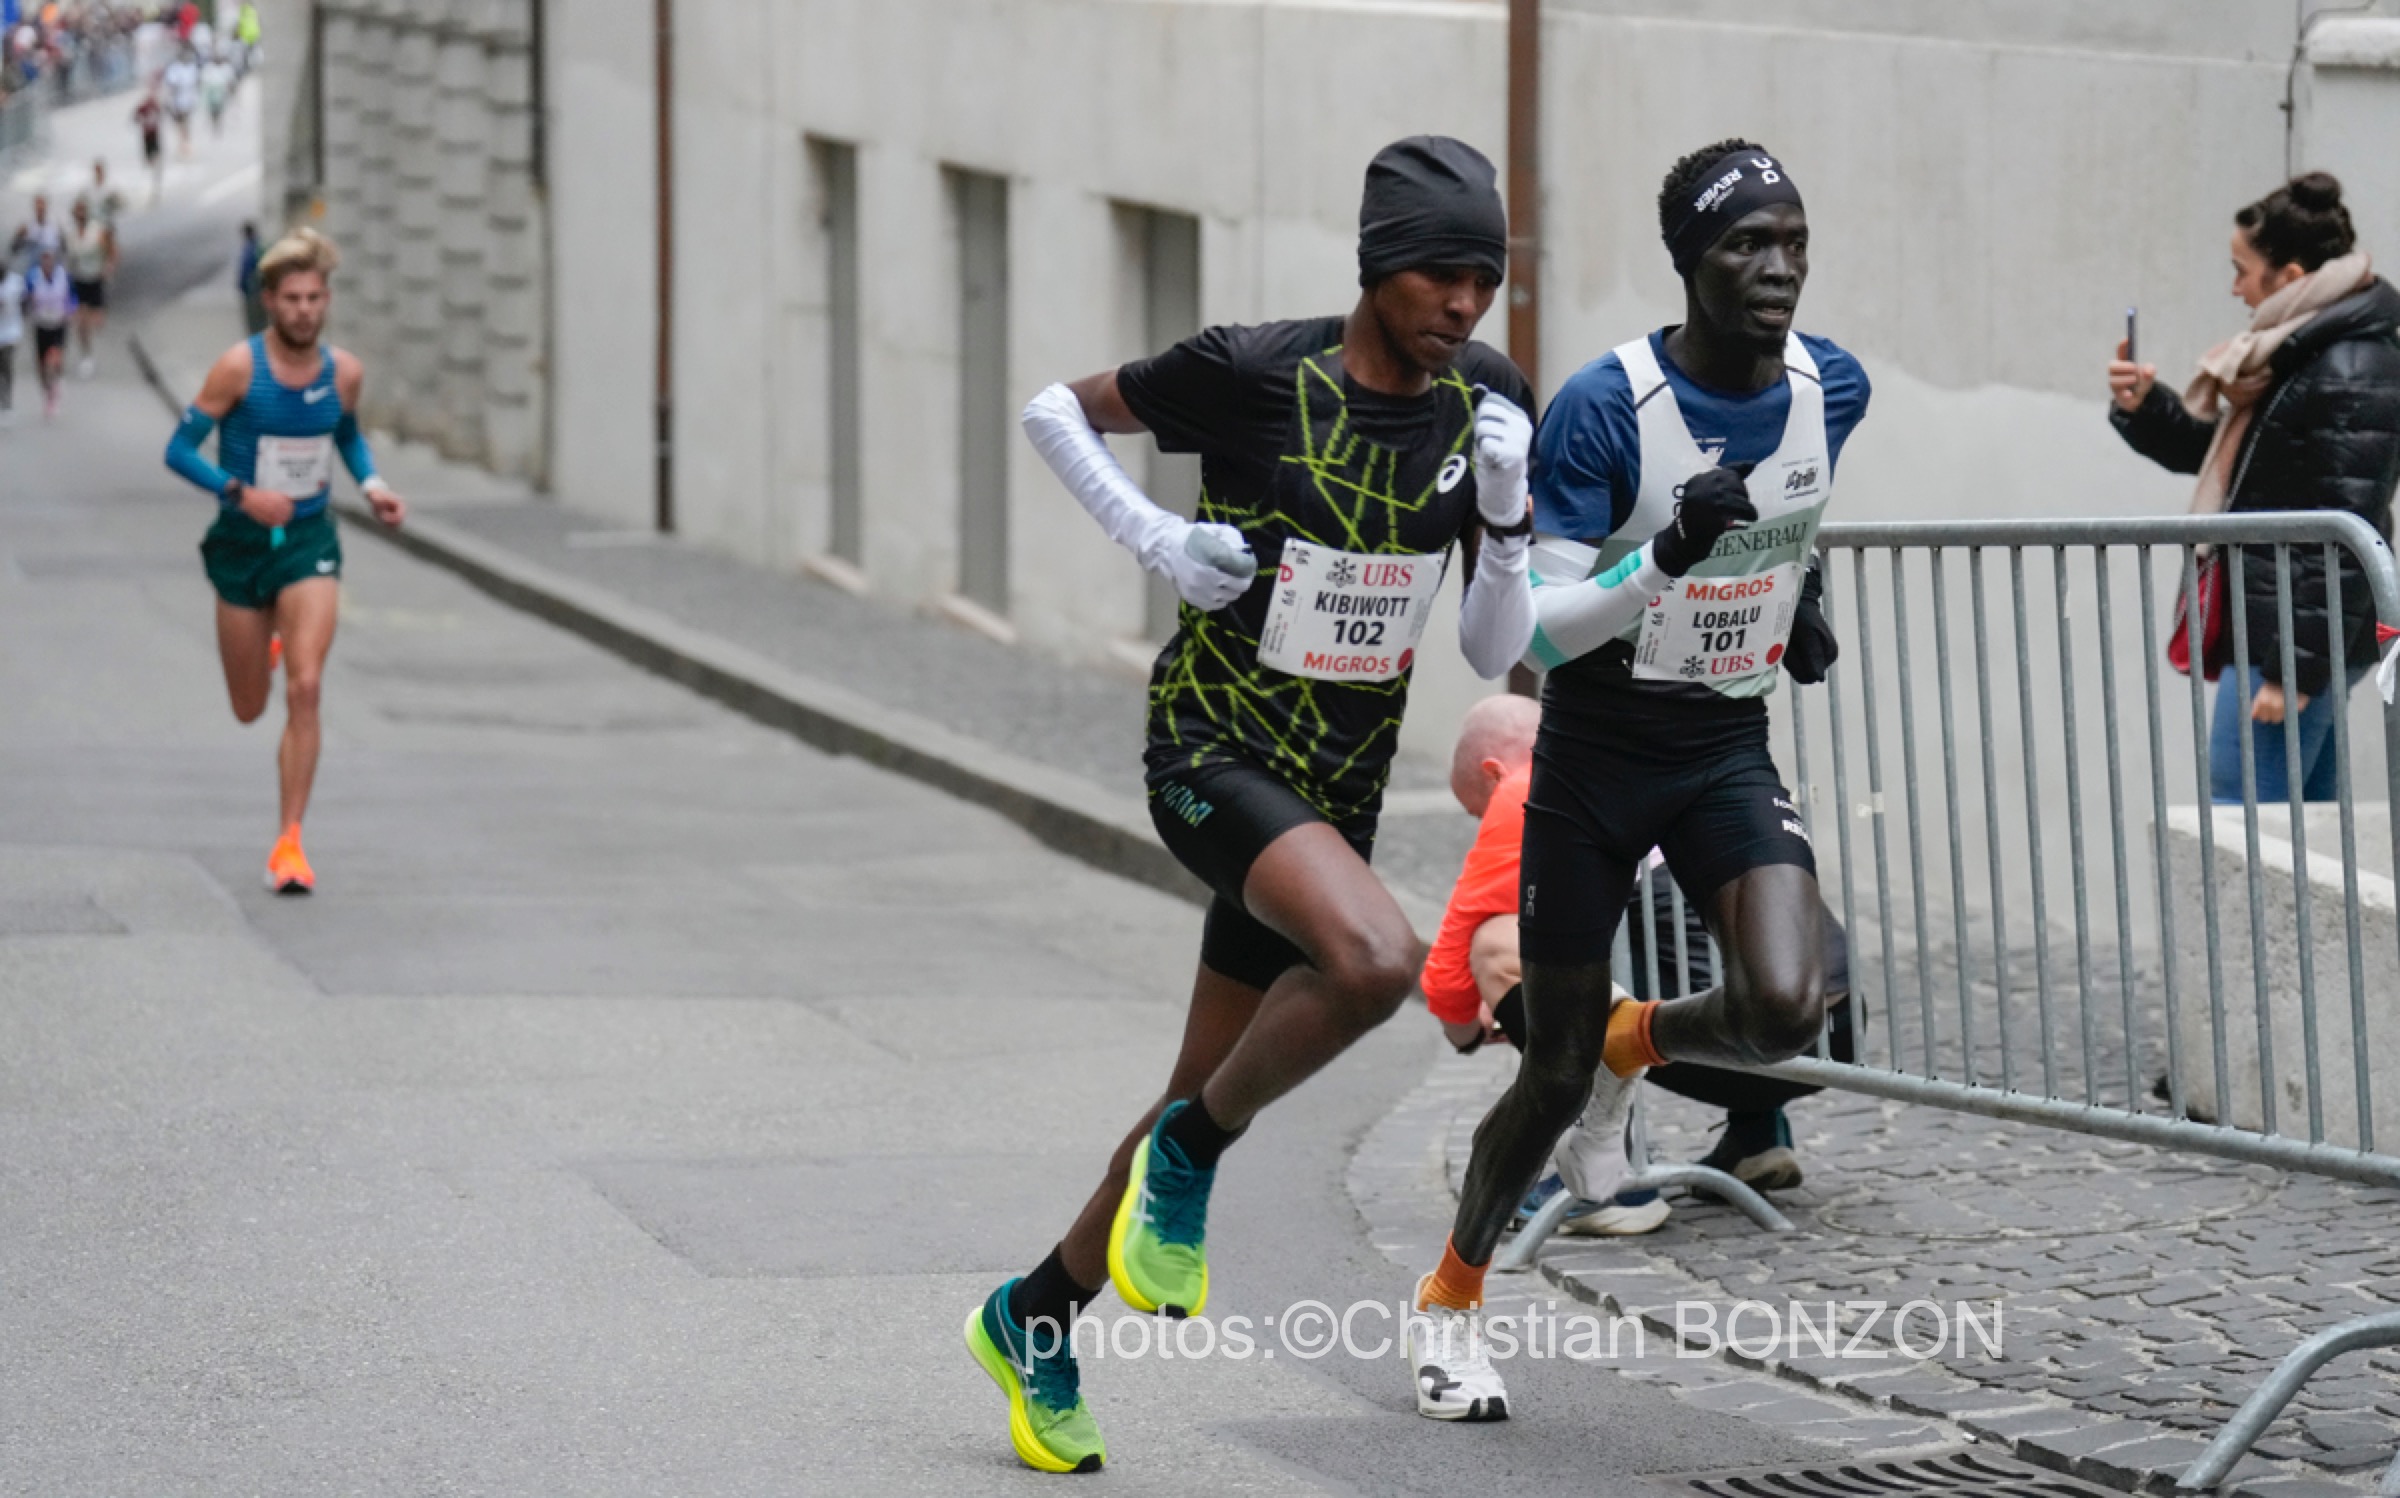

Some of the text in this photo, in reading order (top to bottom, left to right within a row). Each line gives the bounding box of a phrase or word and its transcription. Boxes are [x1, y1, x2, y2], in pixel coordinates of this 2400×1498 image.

[1363, 563, 1415, 587] UBS
[1685, 575, 1775, 601] MIGROS
[1314, 590, 1411, 617] KIBIWOTT
[1692, 605, 1761, 628] LOBALU
[1333, 619, 1386, 646] 102
[1701, 628, 1747, 652] 101
[1303, 651, 1391, 674] MIGROS
[1711, 652, 1755, 675] UBS
